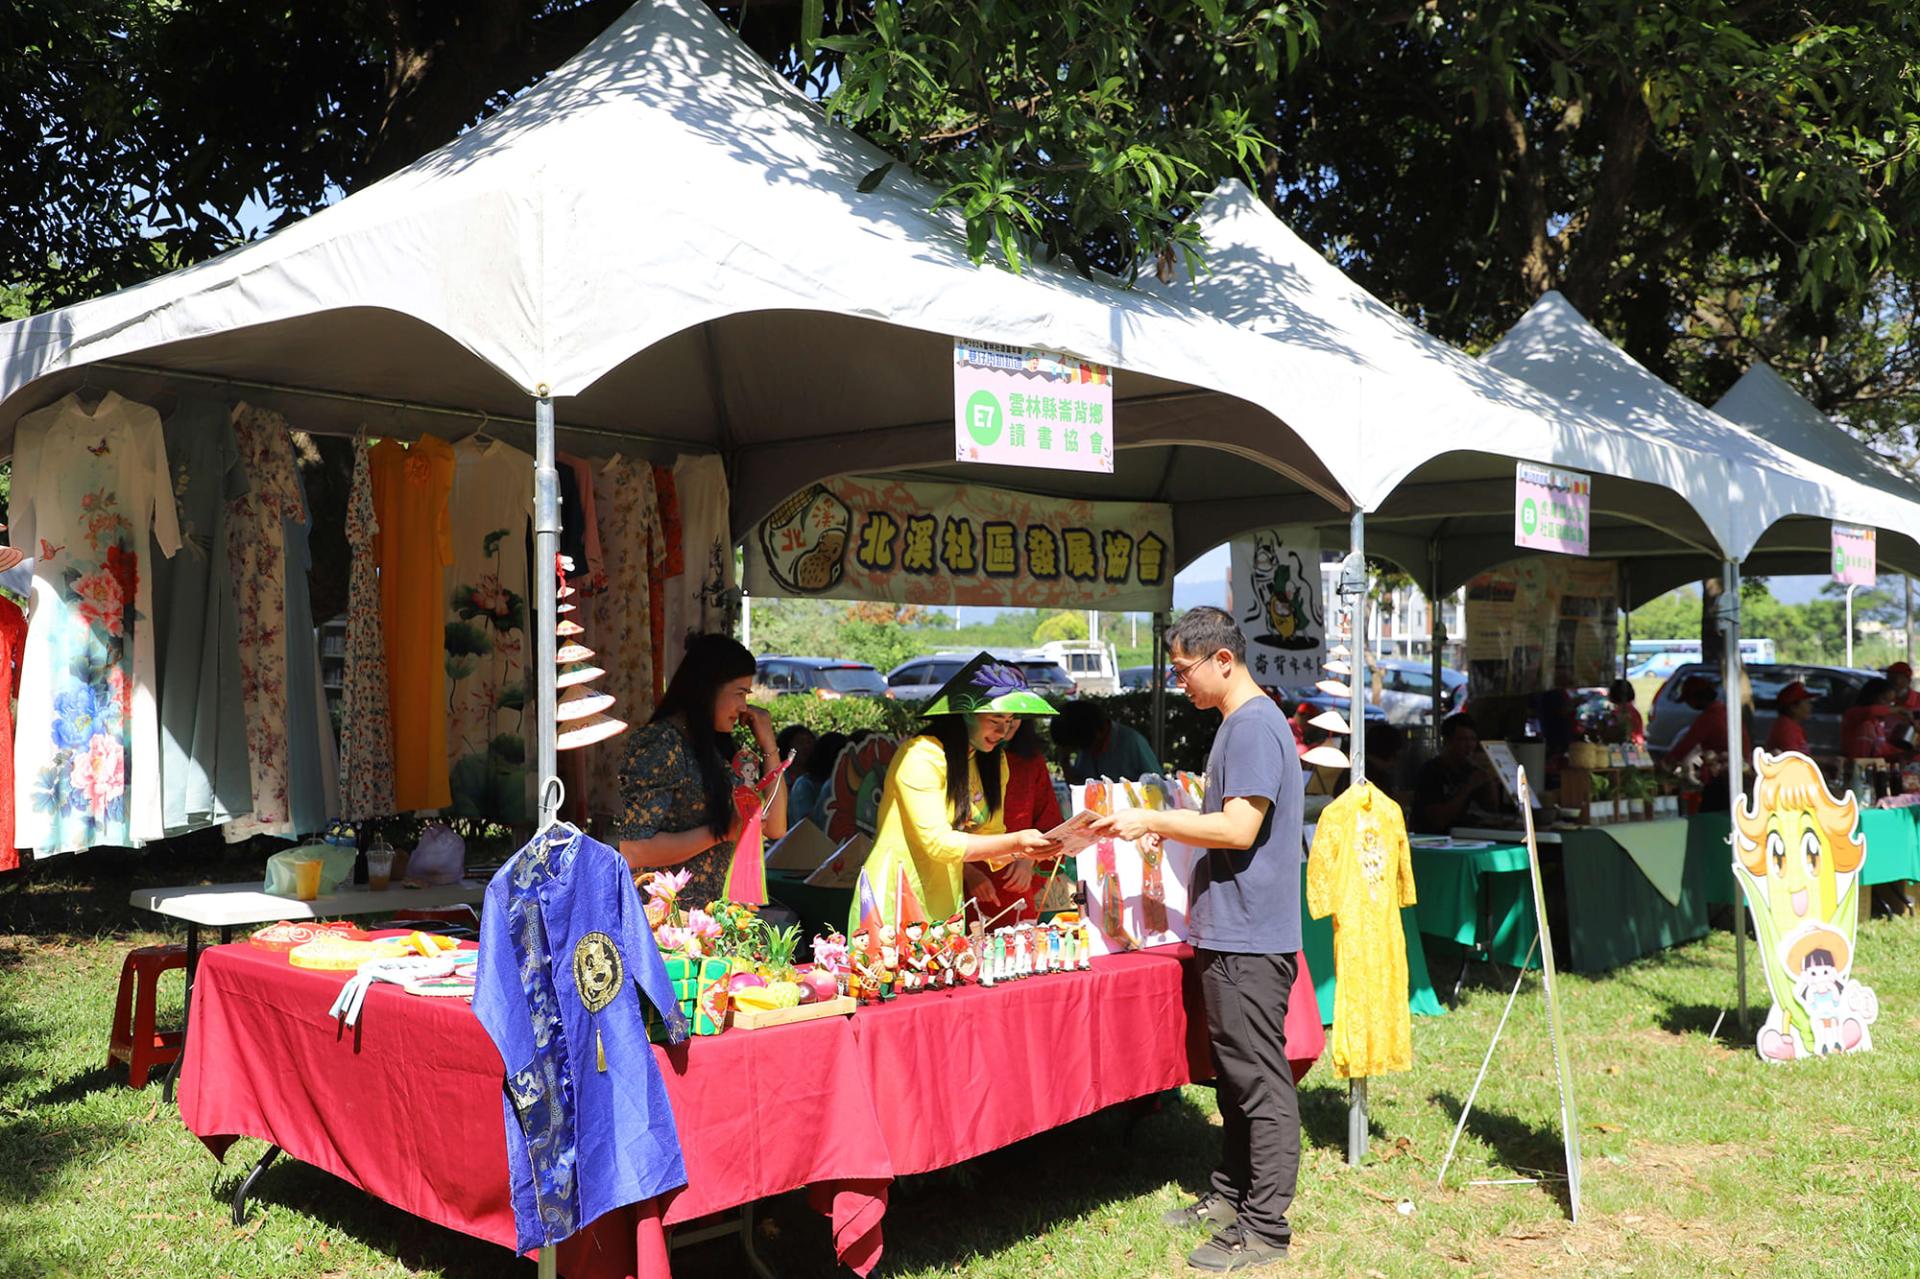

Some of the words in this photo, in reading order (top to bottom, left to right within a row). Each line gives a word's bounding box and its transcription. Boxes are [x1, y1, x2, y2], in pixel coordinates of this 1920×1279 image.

[973, 404, 995, 428] E7
[1008, 392, 1104, 425] 雲林縣崙背鄉
[1008, 423, 1105, 454] 讀書協會
[858, 513, 1166, 585] 北溪社區發展協會
